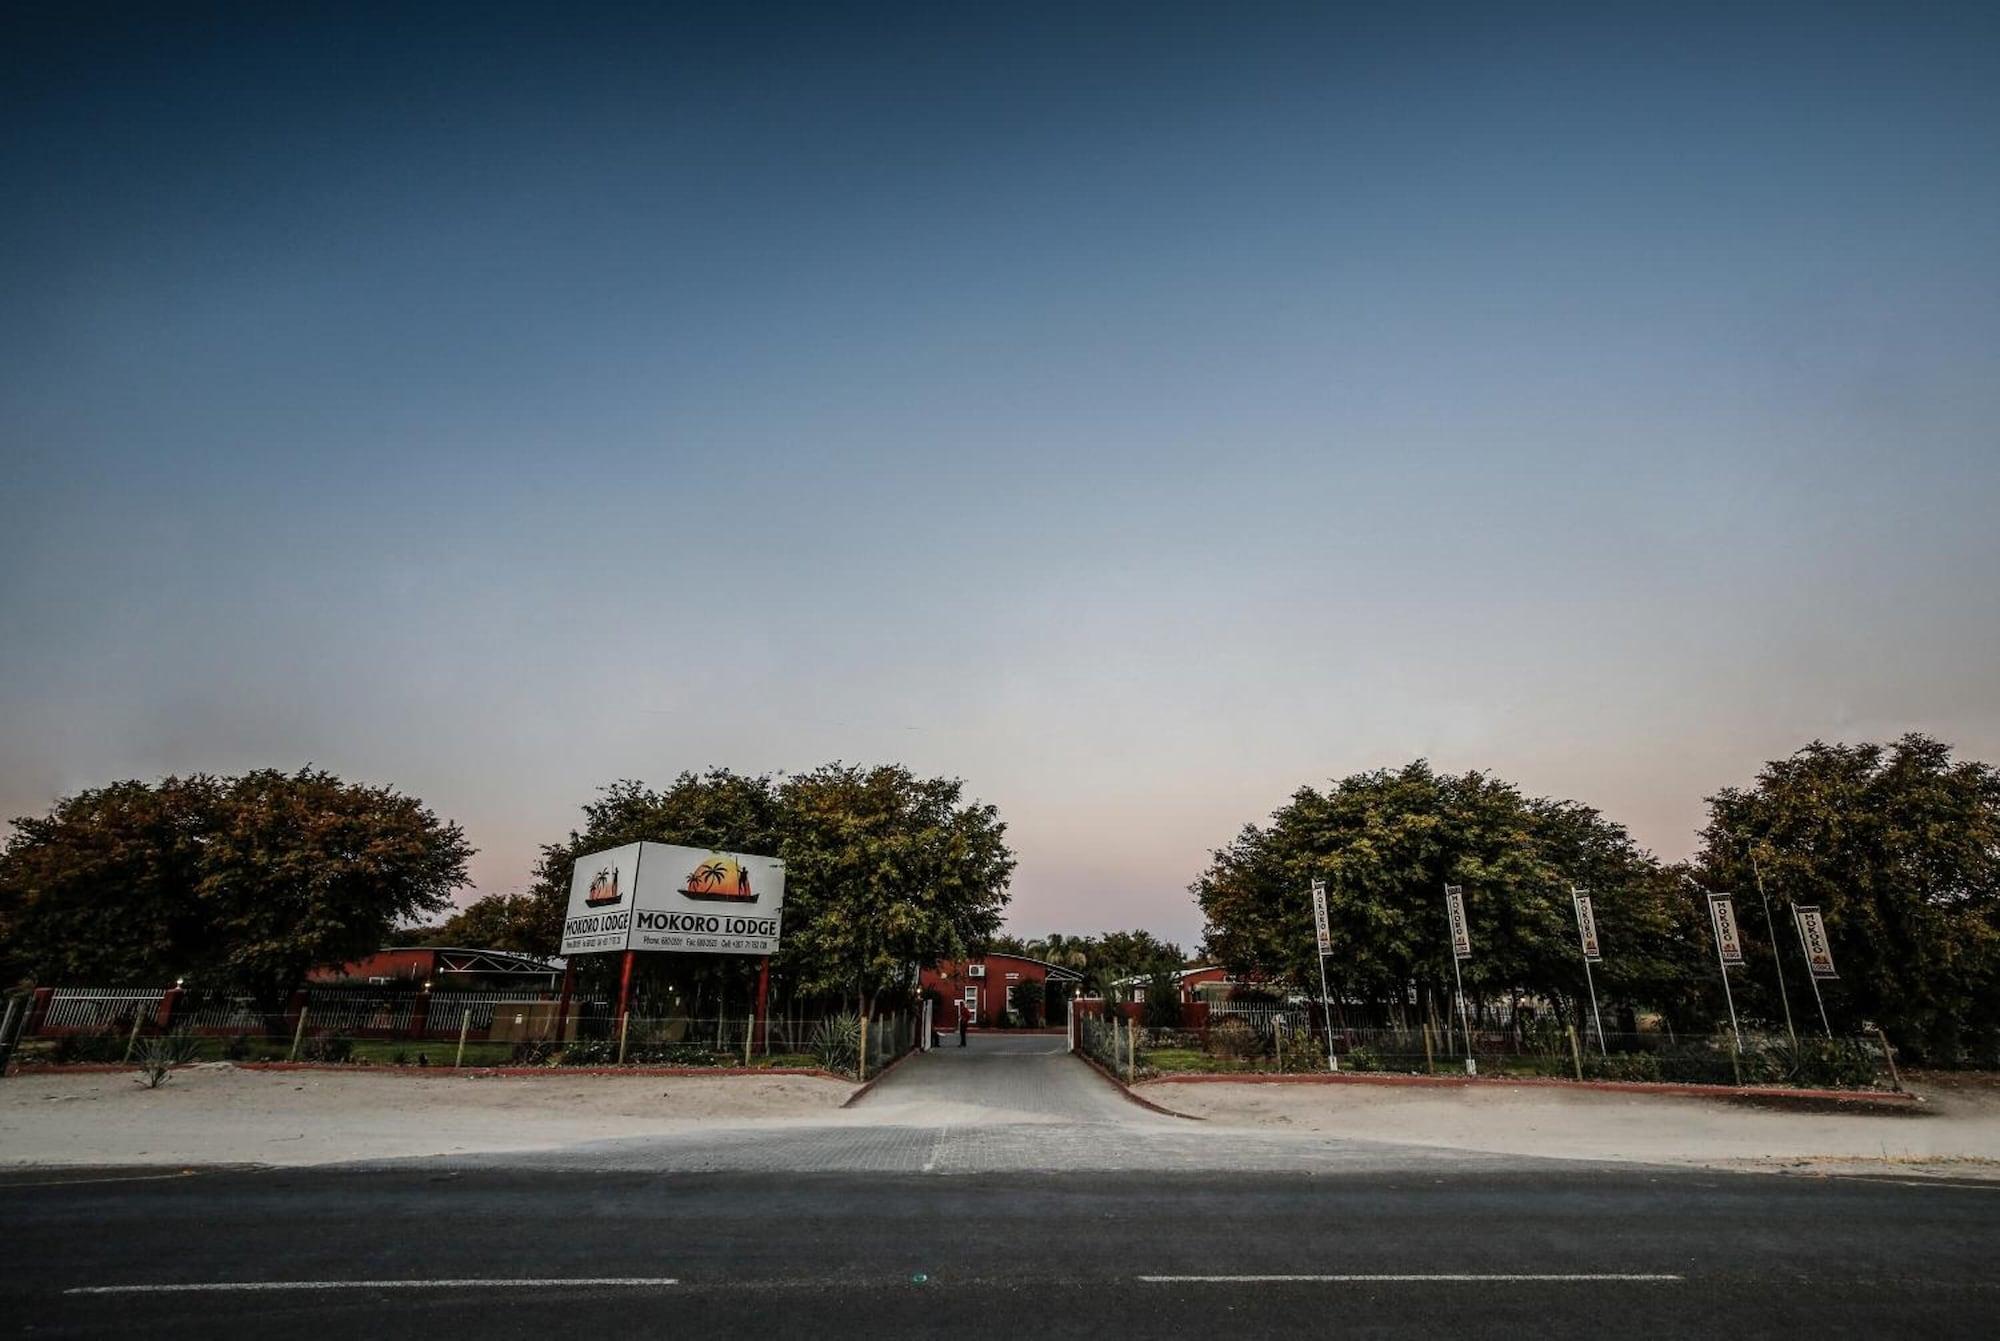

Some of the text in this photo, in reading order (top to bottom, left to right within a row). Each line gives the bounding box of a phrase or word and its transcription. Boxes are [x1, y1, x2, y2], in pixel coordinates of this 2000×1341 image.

[565, 913, 629, 937] MOKORO LODGE
[637, 912, 777, 936] MOKORO LODGE
[1717, 902, 1732, 941] MOKORO
[1804, 914, 1823, 953] MOKORO
